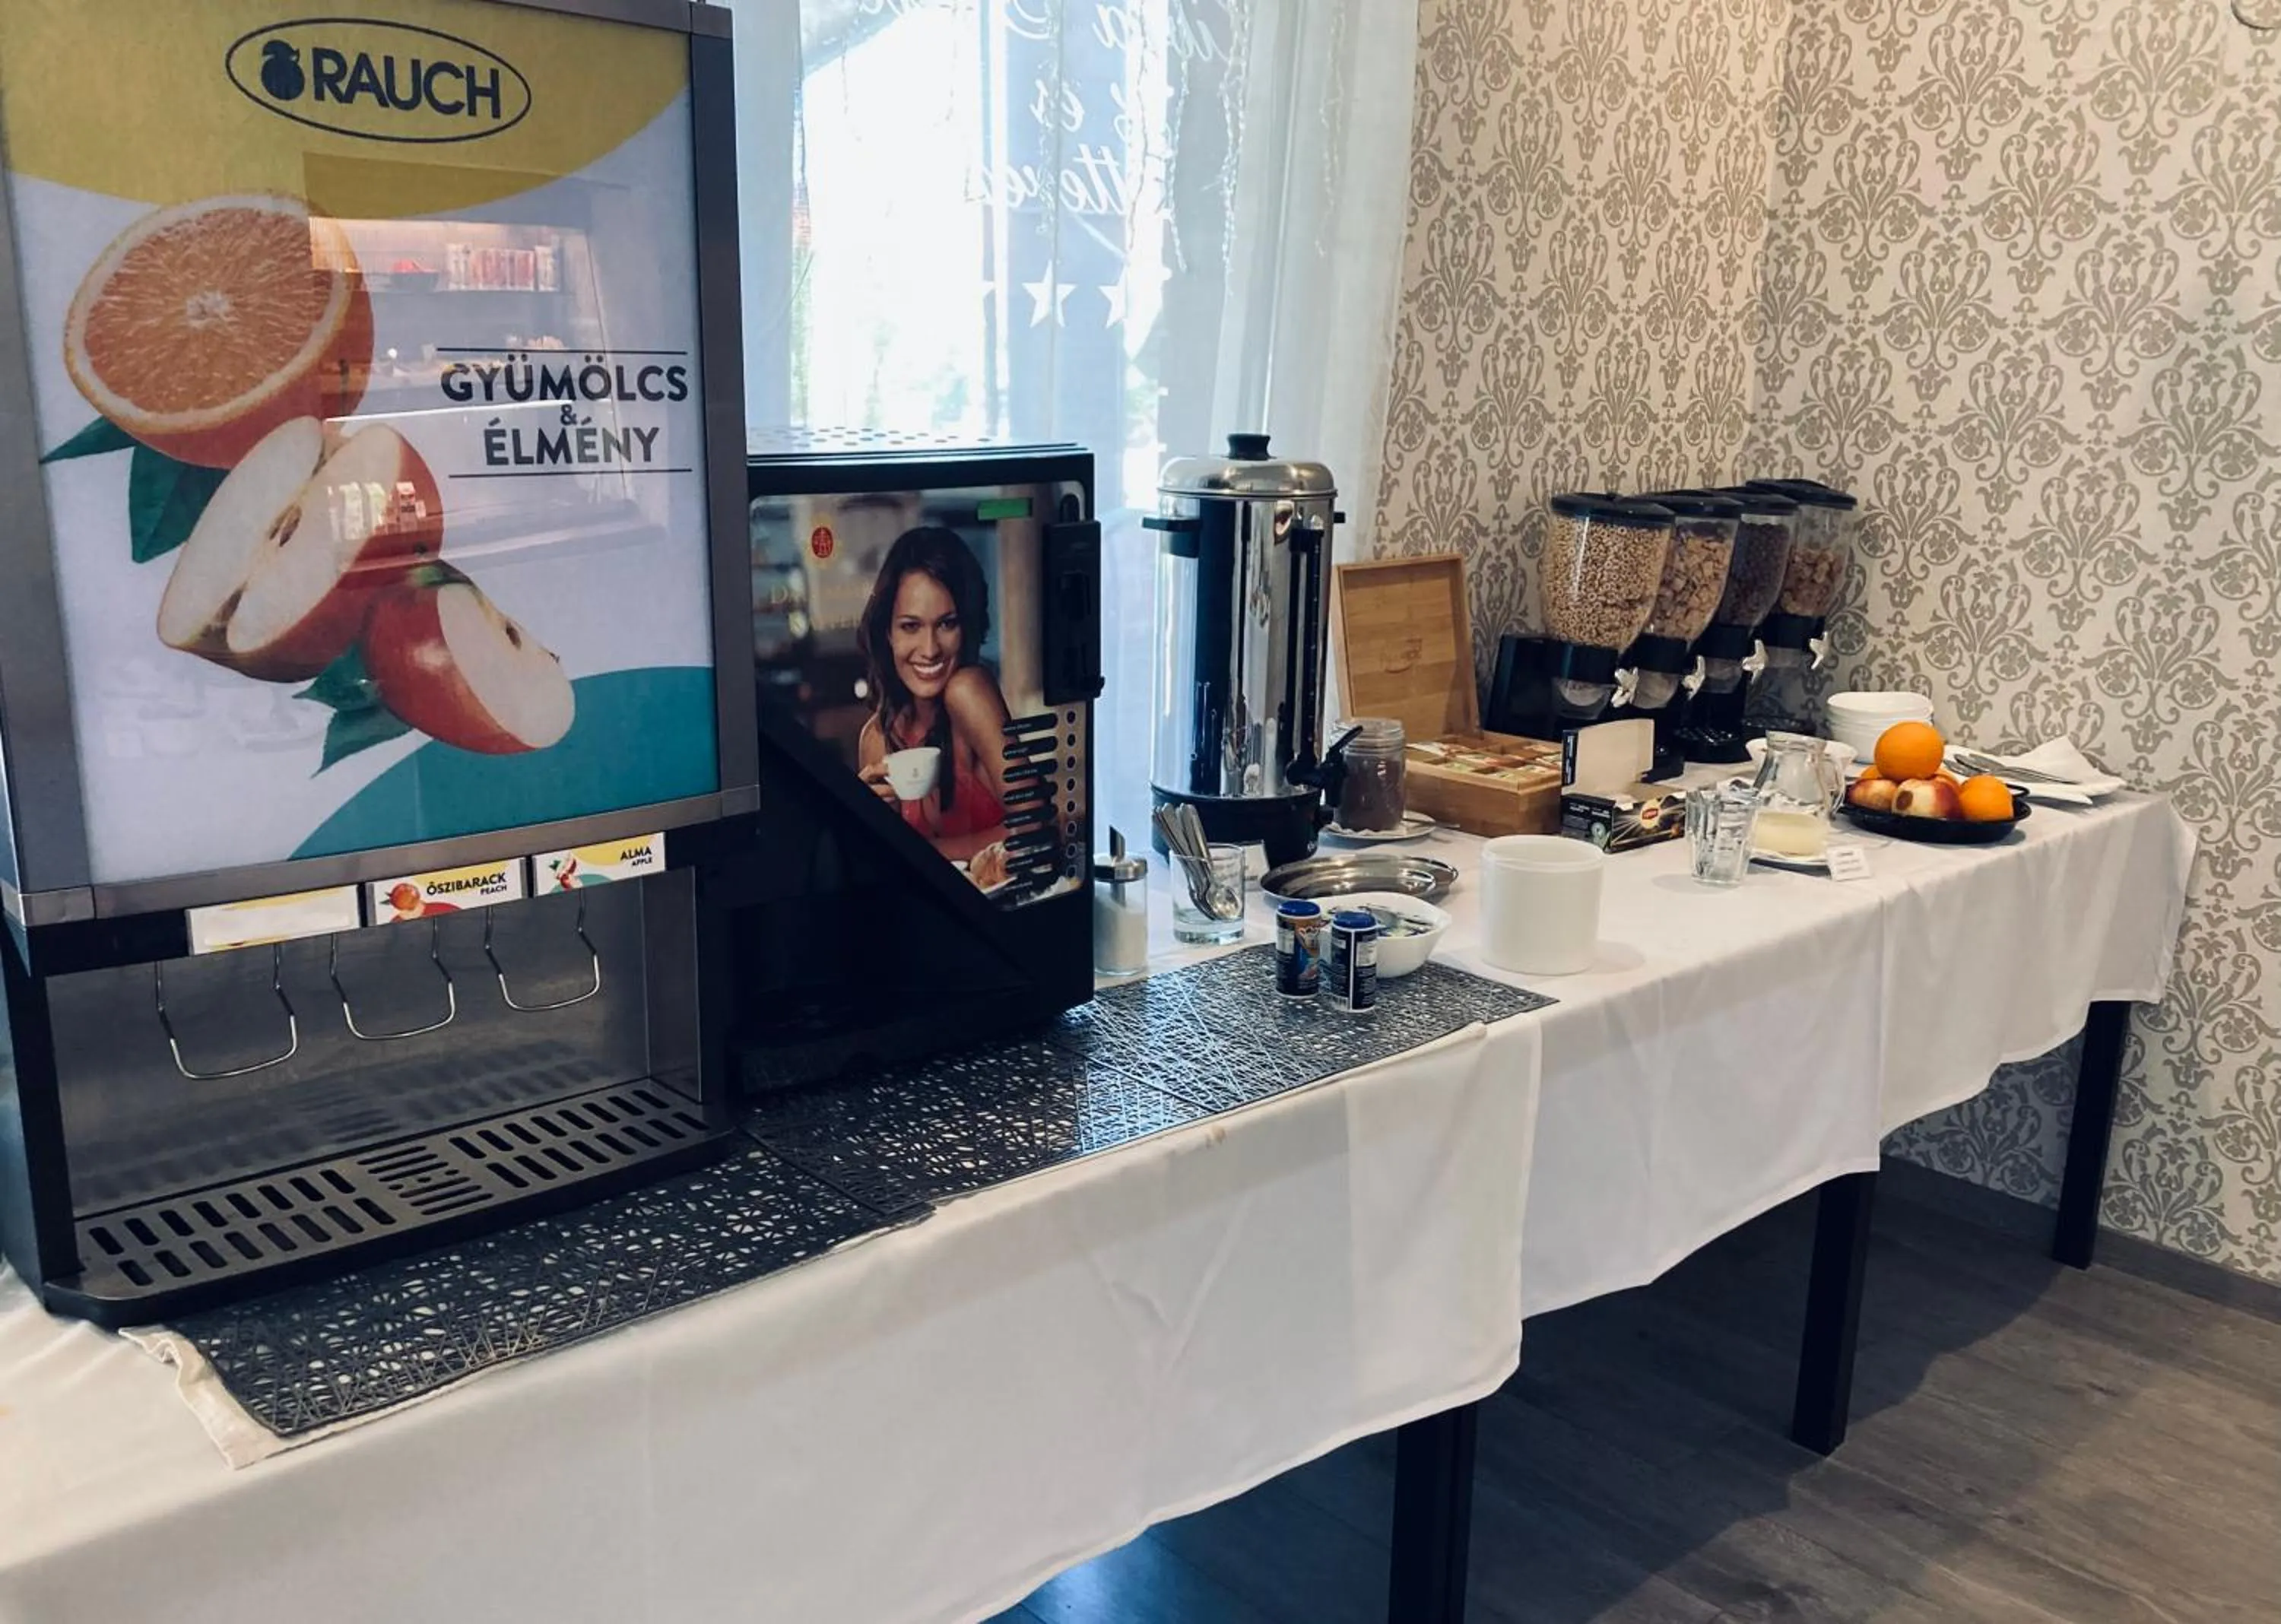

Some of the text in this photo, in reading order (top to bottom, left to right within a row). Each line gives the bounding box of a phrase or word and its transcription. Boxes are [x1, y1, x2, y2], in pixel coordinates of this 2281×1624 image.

[312, 46, 501, 120] RAUCH
[440, 354, 688, 402] GYÜMÖLCS
[560, 404, 578, 426] &
[484, 417, 660, 466] ÉLMÉNY
[620, 845, 652, 861] ALMA
[631, 856, 653, 867] APPLE
[481, 884, 507, 896] PEACH
